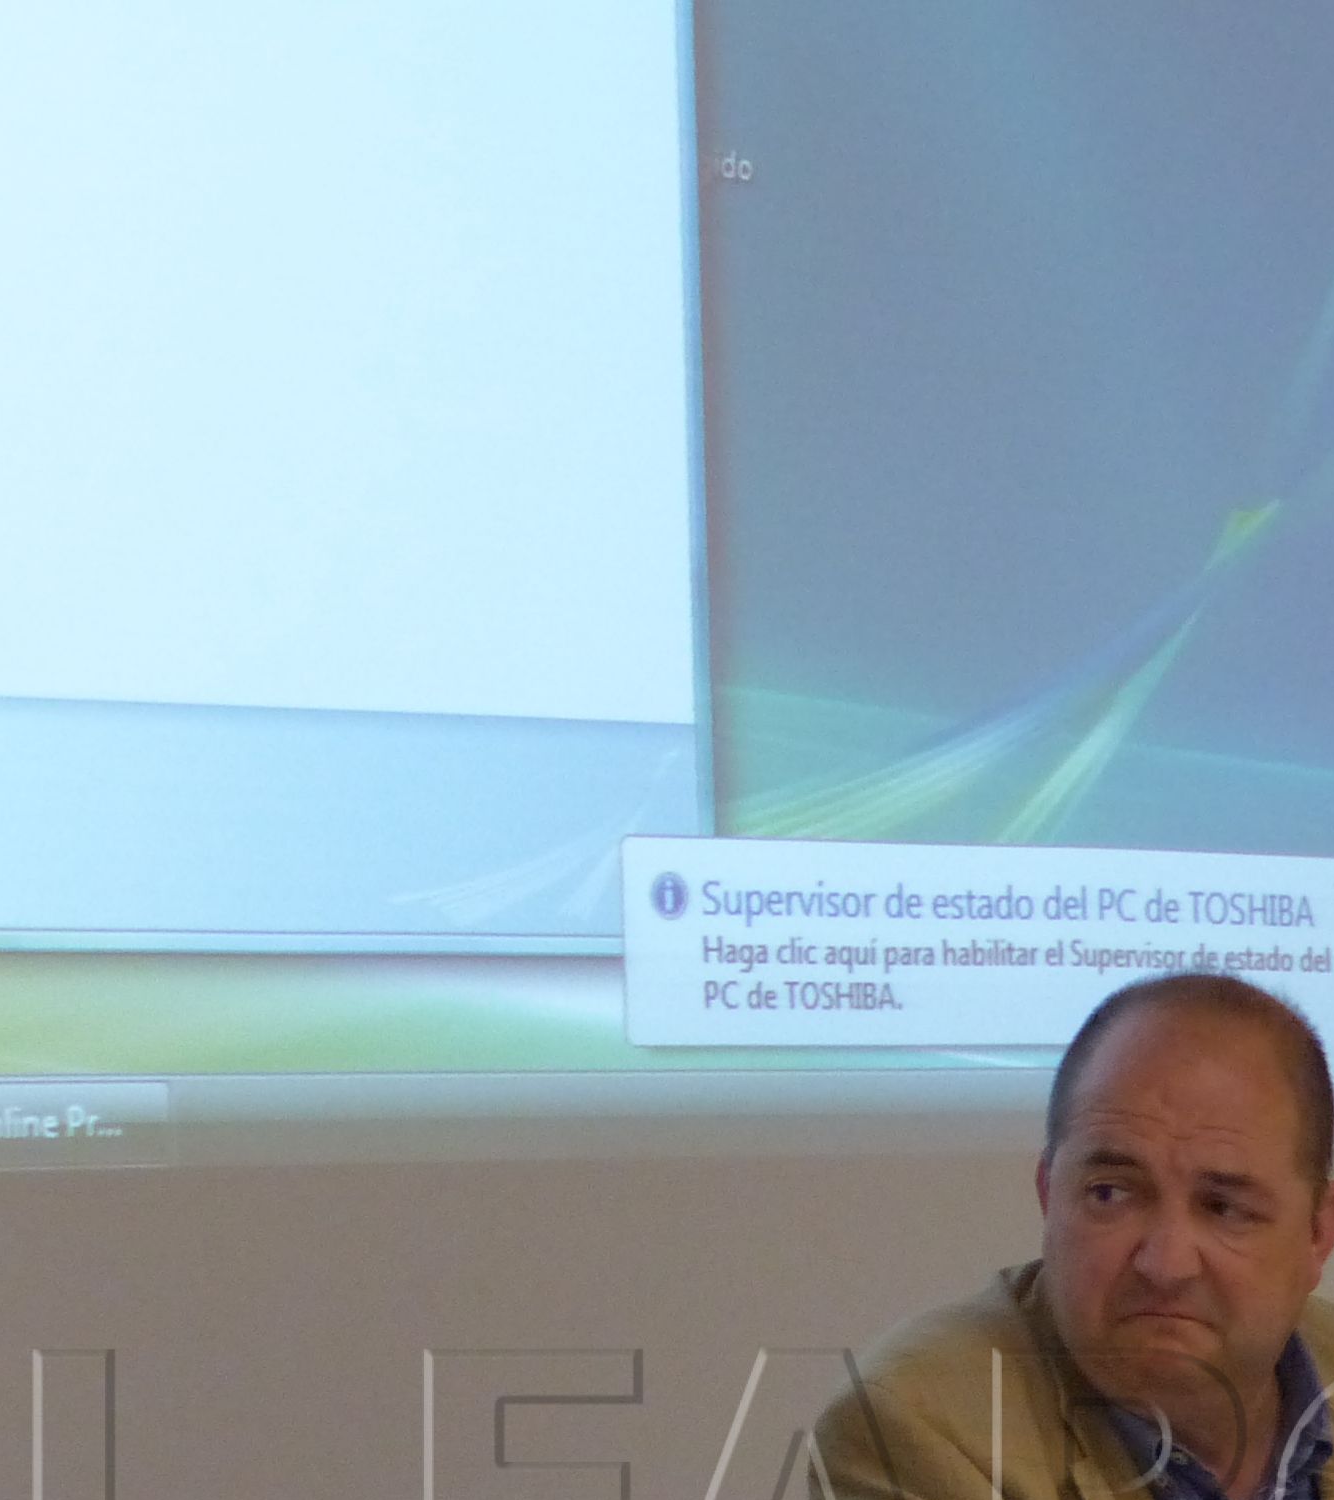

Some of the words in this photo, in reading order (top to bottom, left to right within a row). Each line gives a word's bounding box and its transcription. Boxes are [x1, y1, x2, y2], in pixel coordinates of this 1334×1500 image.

[701, 880, 878, 927] Supervisor
[884, 882, 923, 919] de
[931, 884, 1034, 920] estado
[1043, 885, 1088, 921] del
[1097, 887, 1137, 923] PC
[1144, 888, 1180, 924] de
[1187, 890, 1315, 927] TOSHIBA
[702, 935, 769, 973] Haga
[776, 937, 818, 965] clic
[824, 938, 877, 974] aquí
[884, 945, 936, 974] para
[941, 938, 1037, 967] habilitar
[1045, 940, 1064, 967] el
[1070, 939, 1186, 975] Supervisor
[1192, 943, 1218, 969] de
[1224, 945, 1294, 972] estado
[1299, 946, 1333, 973] del
[704, 980, 739, 1009] PC
[747, 981, 778, 1010] de
[783, 981, 904, 1011] TOSHIBA.
